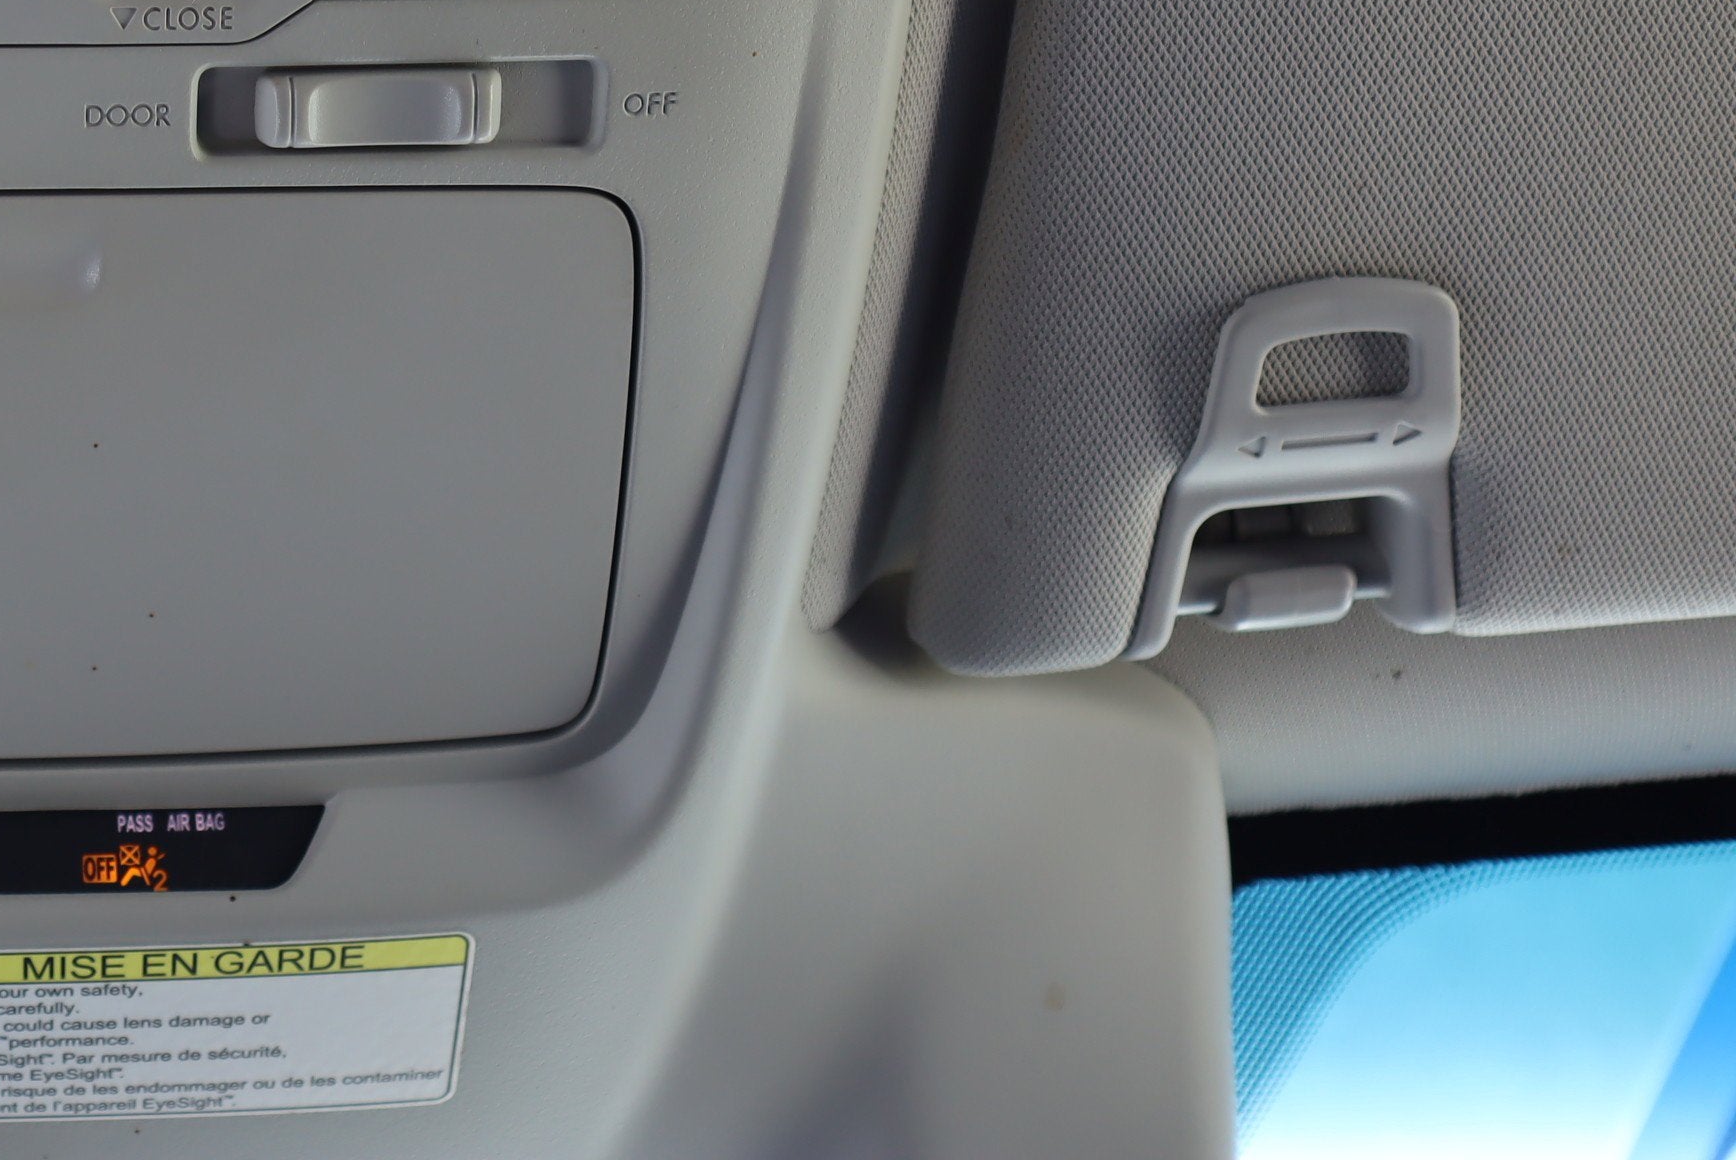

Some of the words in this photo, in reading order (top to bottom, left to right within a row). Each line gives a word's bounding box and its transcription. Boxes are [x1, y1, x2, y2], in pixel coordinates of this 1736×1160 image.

[142, 5, 234, 31] CLOSE
[622, 91, 680, 117] OFF
[84, 103, 171, 129] DOOR
[117, 815, 154, 833] PASS
[167, 814, 191, 832] AIR
[195, 813, 226, 831] BAG
[83, 857, 115, 882] OFF
[22, 954, 125, 981] MISE
[141, 951, 198, 978] EN
[214, 945, 365, 976] GARDE
[35, 987, 74, 998] own
[80, 984, 143, 999] safety,
[3, 1020, 54, 1033] could
[60, 1020, 117, 1031] cause
[123, 1017, 162, 1029] lens
[168, 1015, 245, 1028] damage
[251, 1014, 271, 1025] or
[9, 1035, 134, 1050] performance.
[62, 1053, 94, 1064] Par
[101, 1052, 172, 1063] mesure
[178, 1049, 201, 1061] de
[1, 1085, 57, 1098] risque
[63, 1085, 86, 1097] de
[93, 1083, 118, 1095] les
[125, 1080, 246, 1095] endommager
[253, 1079, 275, 1090] ou
[282, 1076, 304, 1088] de
[311, 1075, 336, 1087] les
[342, 1069, 444, 1086] contaminer
[24, 1101, 47, 1113] de
